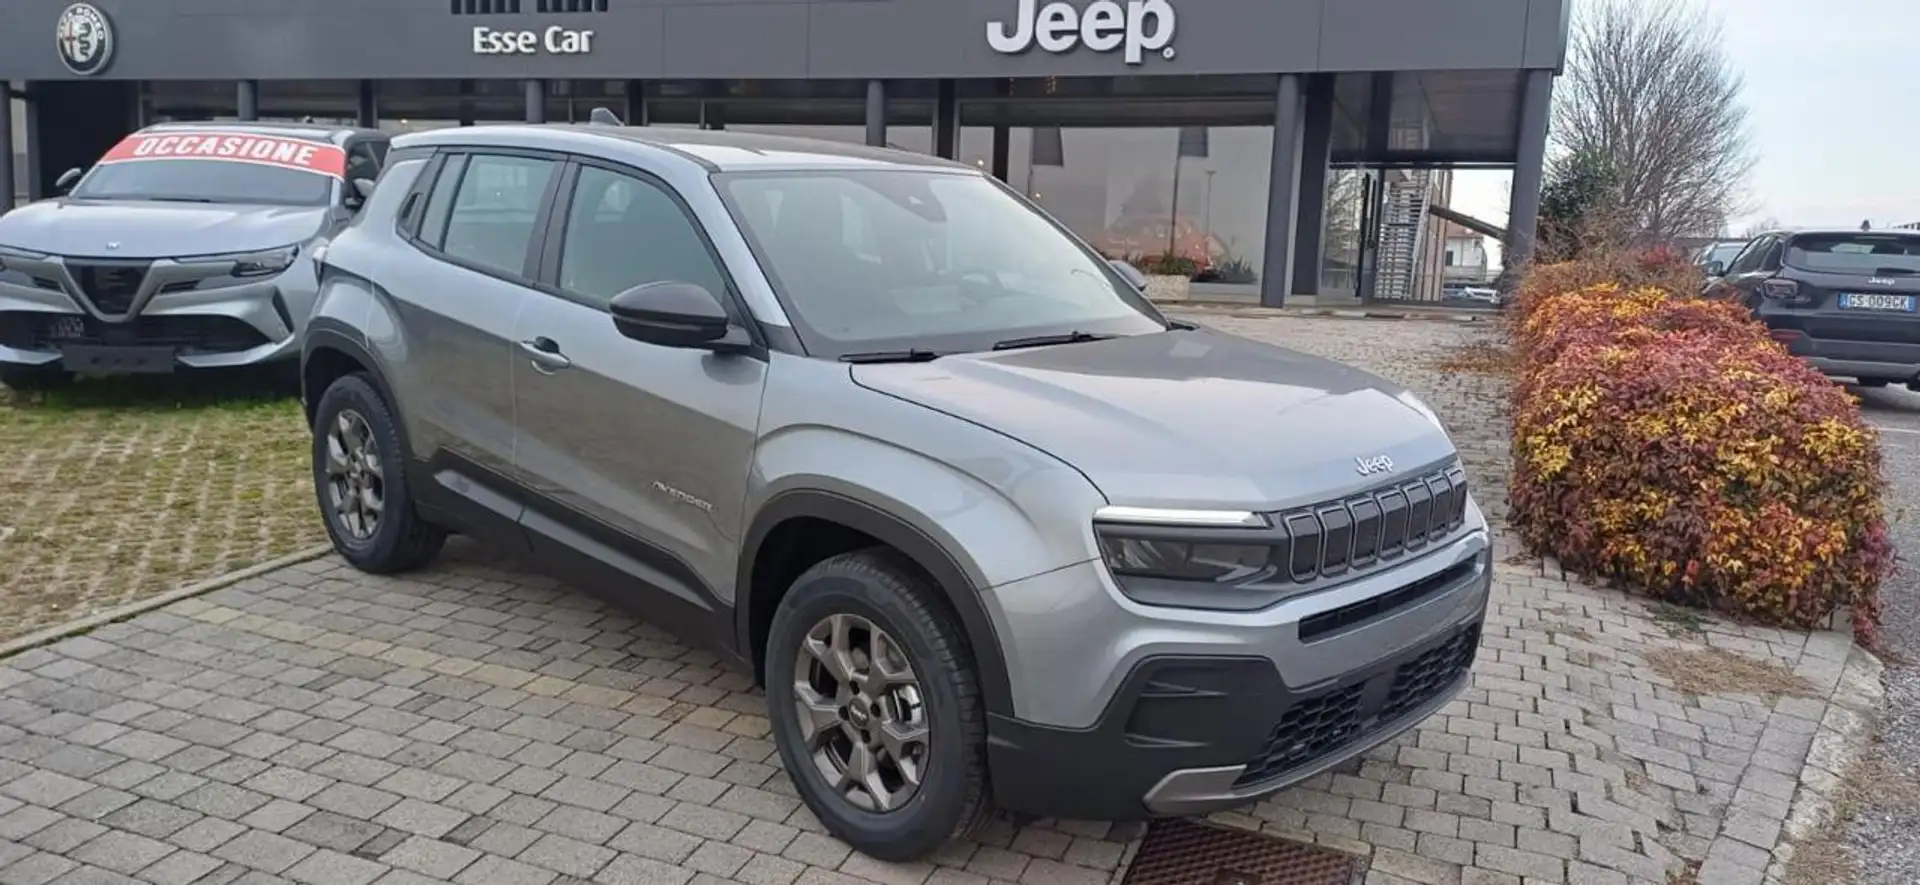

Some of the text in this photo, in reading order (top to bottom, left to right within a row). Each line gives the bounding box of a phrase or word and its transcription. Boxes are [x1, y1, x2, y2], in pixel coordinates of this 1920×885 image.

[473, 25, 594, 53] Esse Car
[986, 0, 1175, 63] Jeep
[134, 136, 318, 165] OCCASIONE
[1867, 276, 1895, 286] Jeep
[1356, 455, 1393, 474] Jeep
